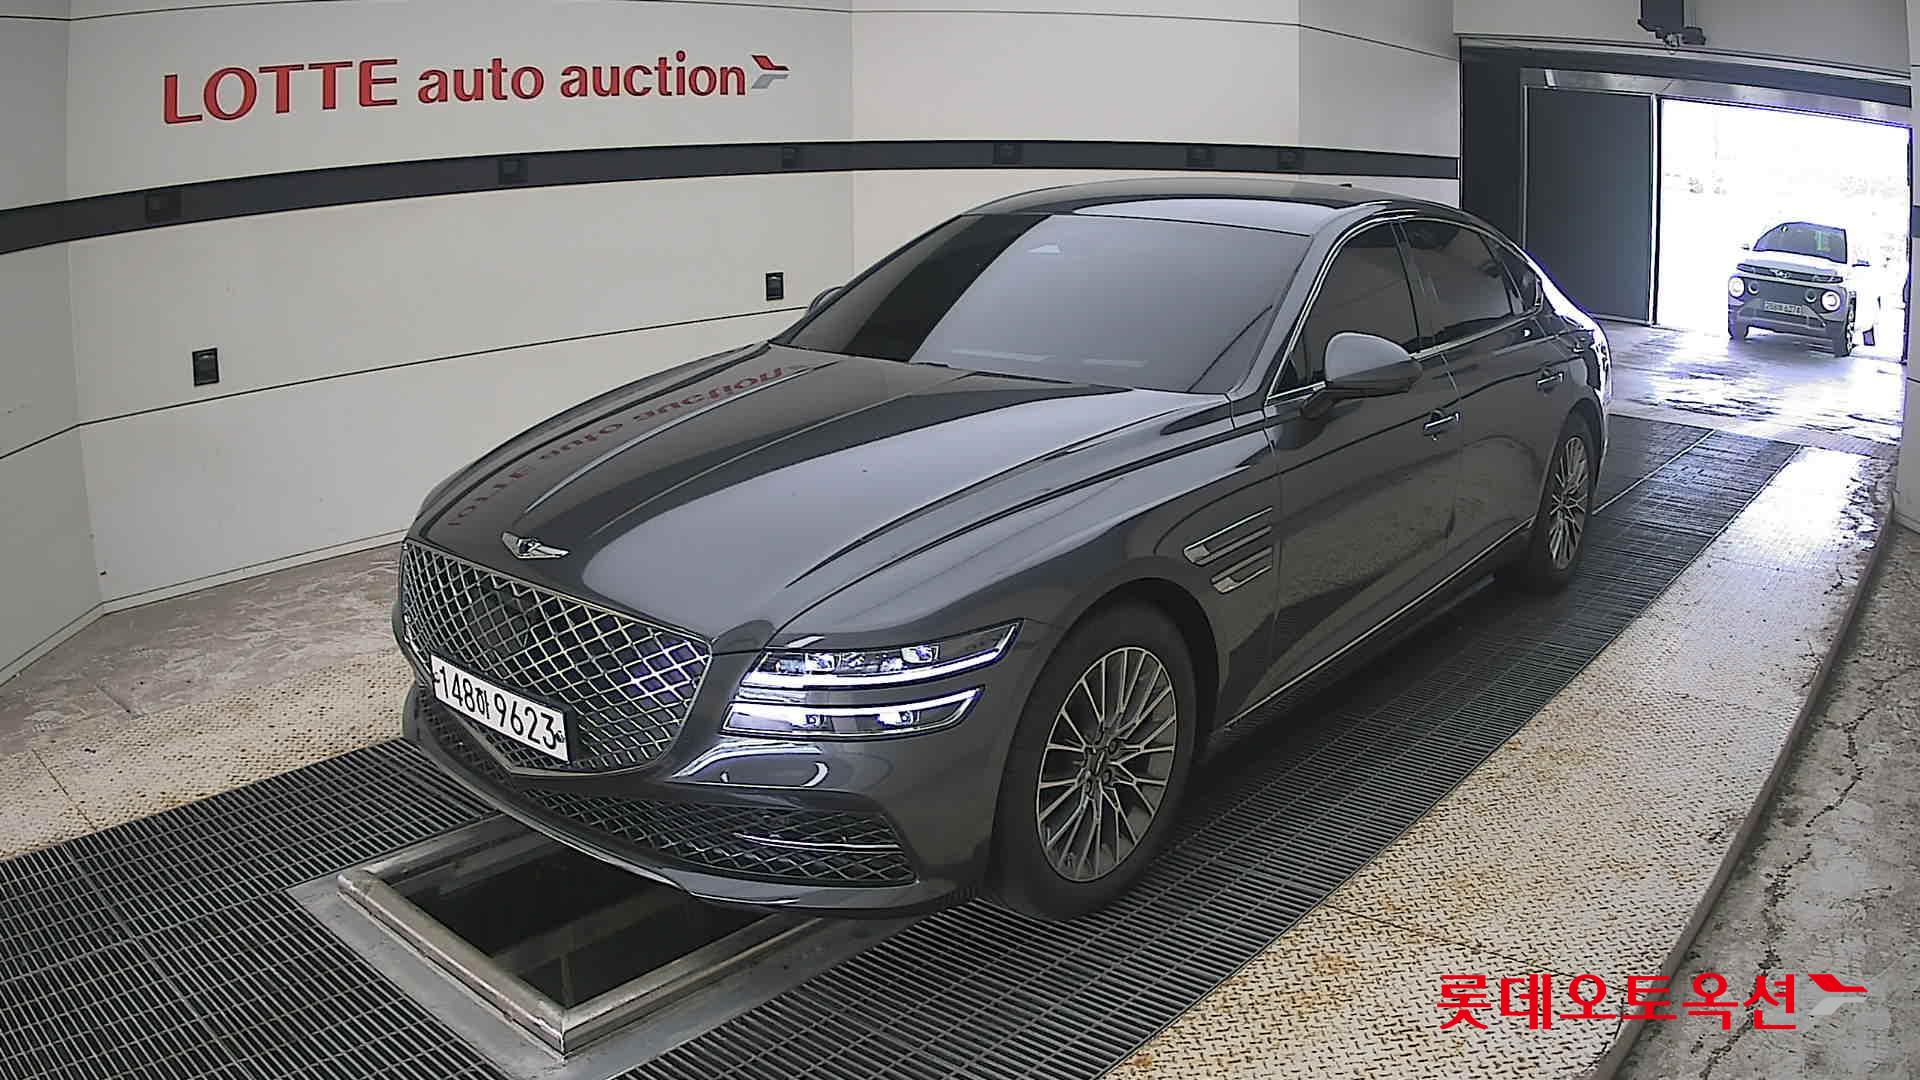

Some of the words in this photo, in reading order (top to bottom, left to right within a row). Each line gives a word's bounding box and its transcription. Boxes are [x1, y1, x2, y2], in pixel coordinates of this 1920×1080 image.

[163, 58, 398, 125] LOTTE
[417, 57, 545, 104] auto
[560, 50, 747, 98] auction
[494, 693, 557, 750] 9623
